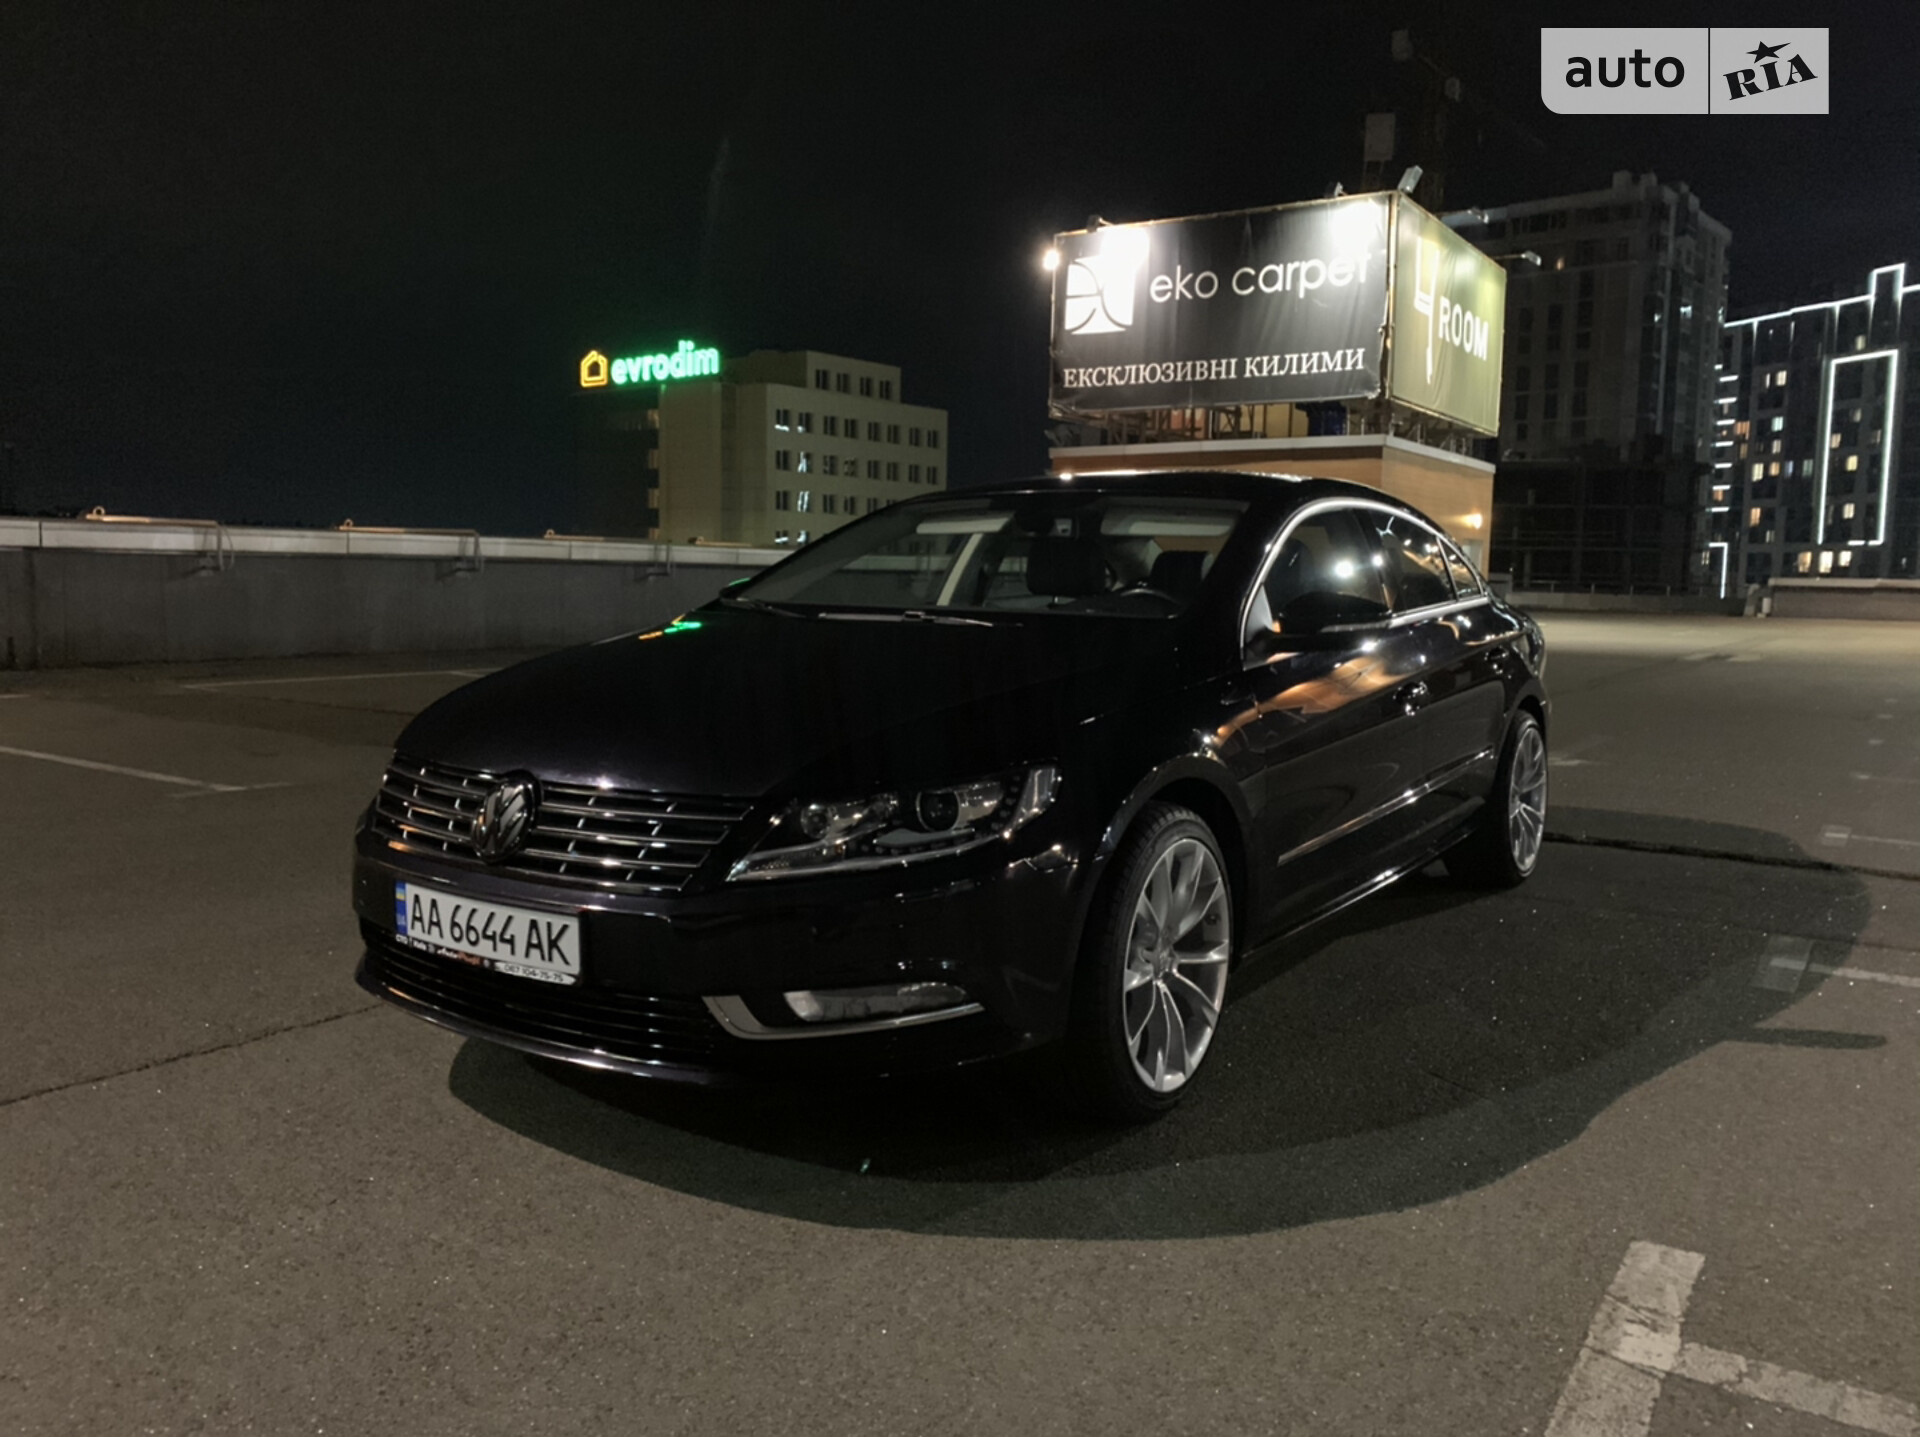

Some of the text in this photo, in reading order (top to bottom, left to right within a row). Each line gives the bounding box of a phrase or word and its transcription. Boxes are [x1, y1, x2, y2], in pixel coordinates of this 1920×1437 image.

[1149, 251, 1372, 303] eko carpet
[1438, 295, 1489, 361] ROOM
[611, 340, 720, 385] evrodim
[1063, 347, 1366, 389] ЕКСКЛЮЗИВНІ КИЛИМИ
[410, 893, 572, 967] AA 6644 AK
